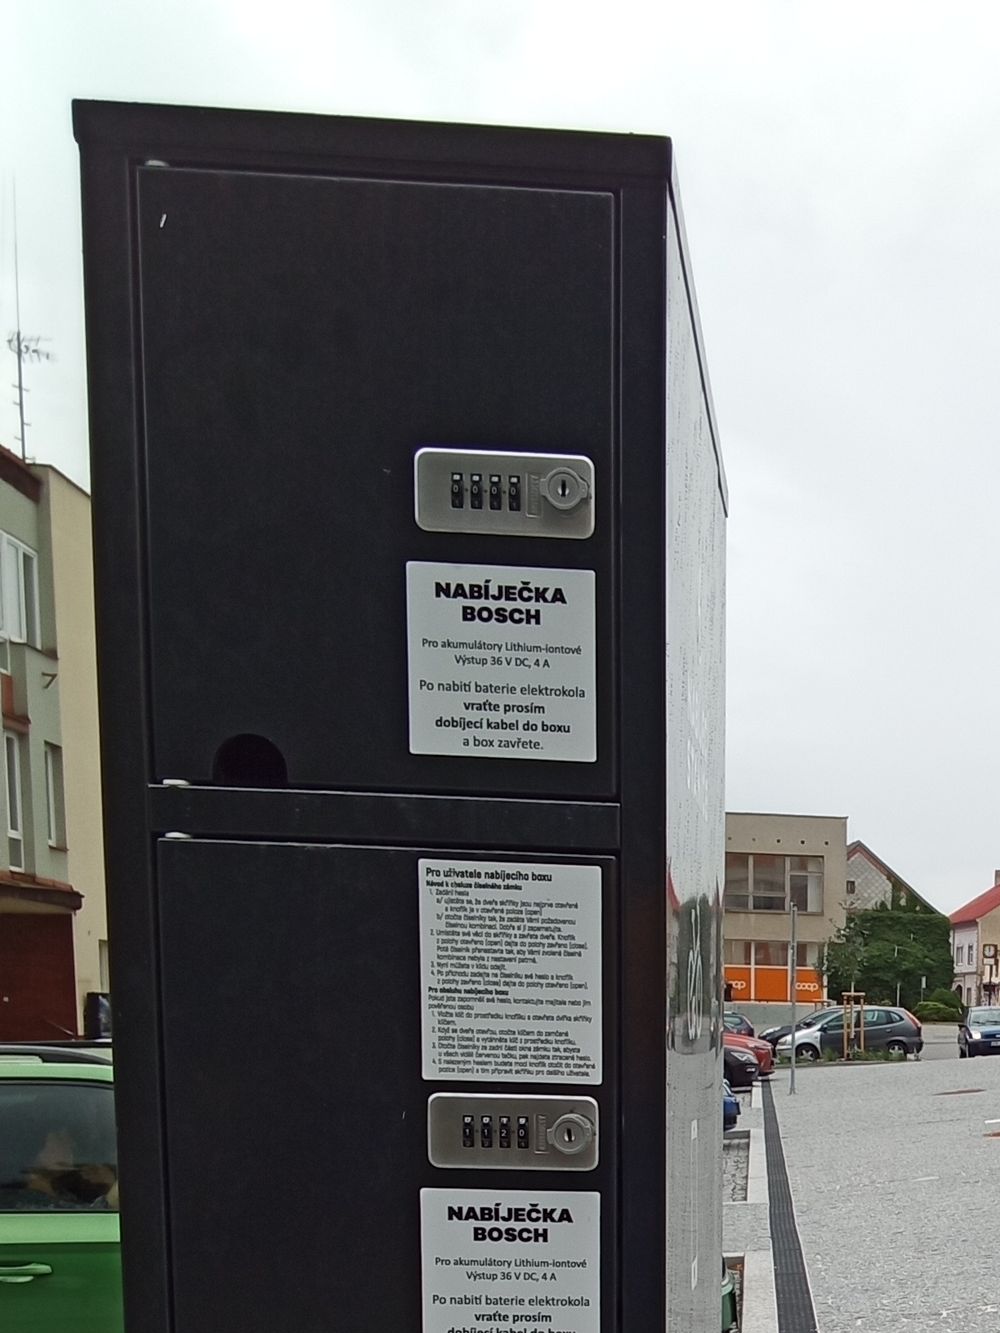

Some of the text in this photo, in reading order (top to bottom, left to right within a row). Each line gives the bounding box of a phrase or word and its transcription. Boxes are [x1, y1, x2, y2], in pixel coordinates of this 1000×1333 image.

[435, 578, 567, 605] NABÍJEČKA
[461, 604, 541, 626] BOSCH
[421, 637, 581, 655] Pro akumulátory Lithium-iontové
[454, 653, 550, 669] Výstup 36 V DC, 4 A
[419, 679, 585, 698] Po nabití baterie elektrokola
[462, 697, 545, 716] vraťte prosím
[434, 715, 570, 733] dobíjecí kabel do boxu
[462, 735, 543, 750] a box zavřete.
[426, 867, 440, 876] Pro
[795, 982, 819, 992] coop
[448, 1203, 573, 1223] NABÍJEČKA
[472, 1226, 548, 1243] BOSCH
[434, 1256, 587, 1269] Pro akumulátory Lithium-iontové
[465, 1270, 557, 1282] Výstup 36 V DC, 4 A
[432, 1293, 590, 1307] Po nabití baterie elektrokola
[474, 1310, 552, 1325] vraťte prosím
